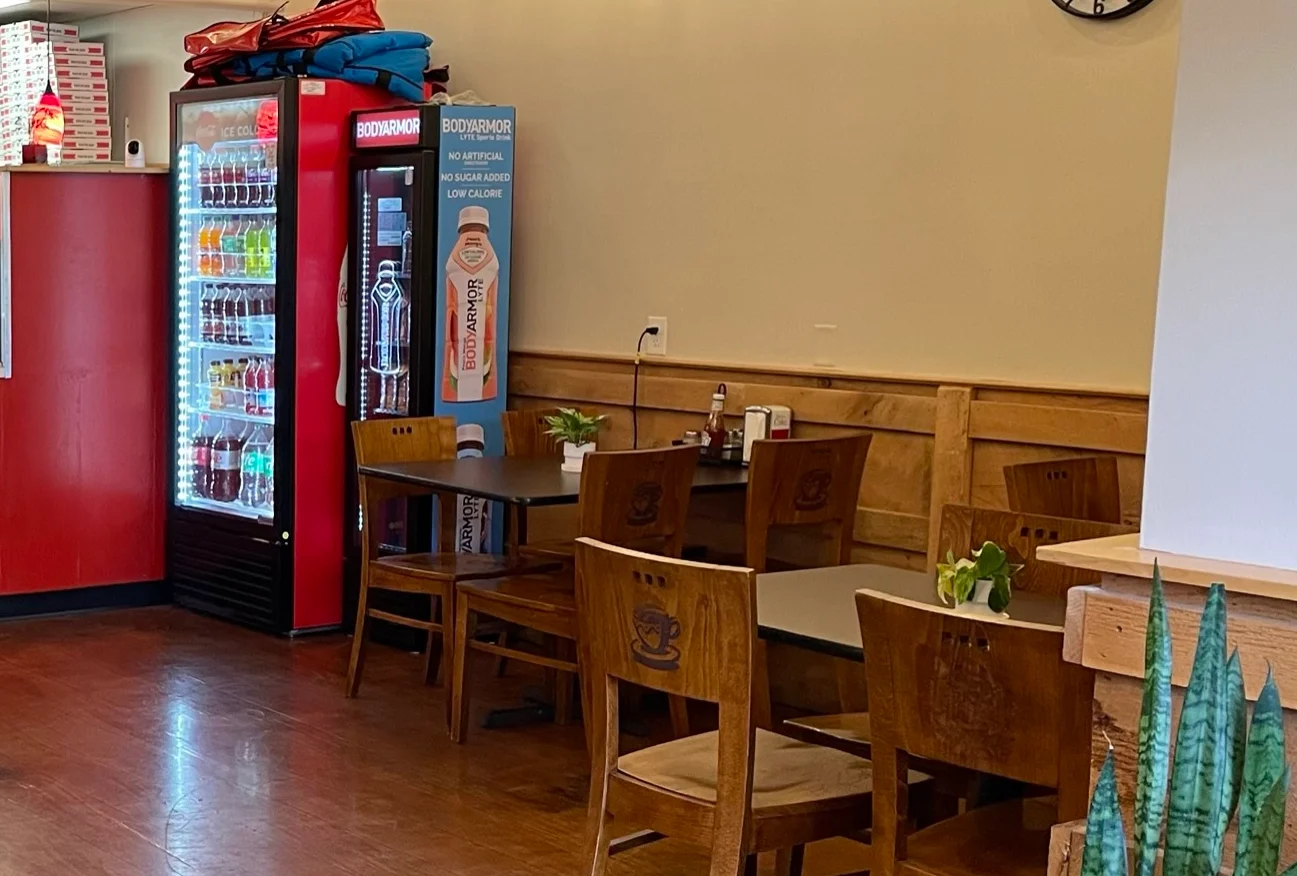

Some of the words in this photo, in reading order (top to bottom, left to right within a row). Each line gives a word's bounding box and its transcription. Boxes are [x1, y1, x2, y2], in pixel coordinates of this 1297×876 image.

[221, 126, 235, 138] ICE
[356, 117, 421, 138] BODYARMOR
[442, 118, 512, 134] BODYARMOR
[448, 151, 461, 161] NO
[462, 151, 504, 161] ARTIFICIAL
[441, 172, 454, 182] NO
[454, 172, 482, 182] SUGAR
[483, 172, 511, 182] ADDED
[447, 189, 467, 199] LOW
[468, 189, 503, 199] CALORIE
[465, 279, 478, 371] BODYARMOR
